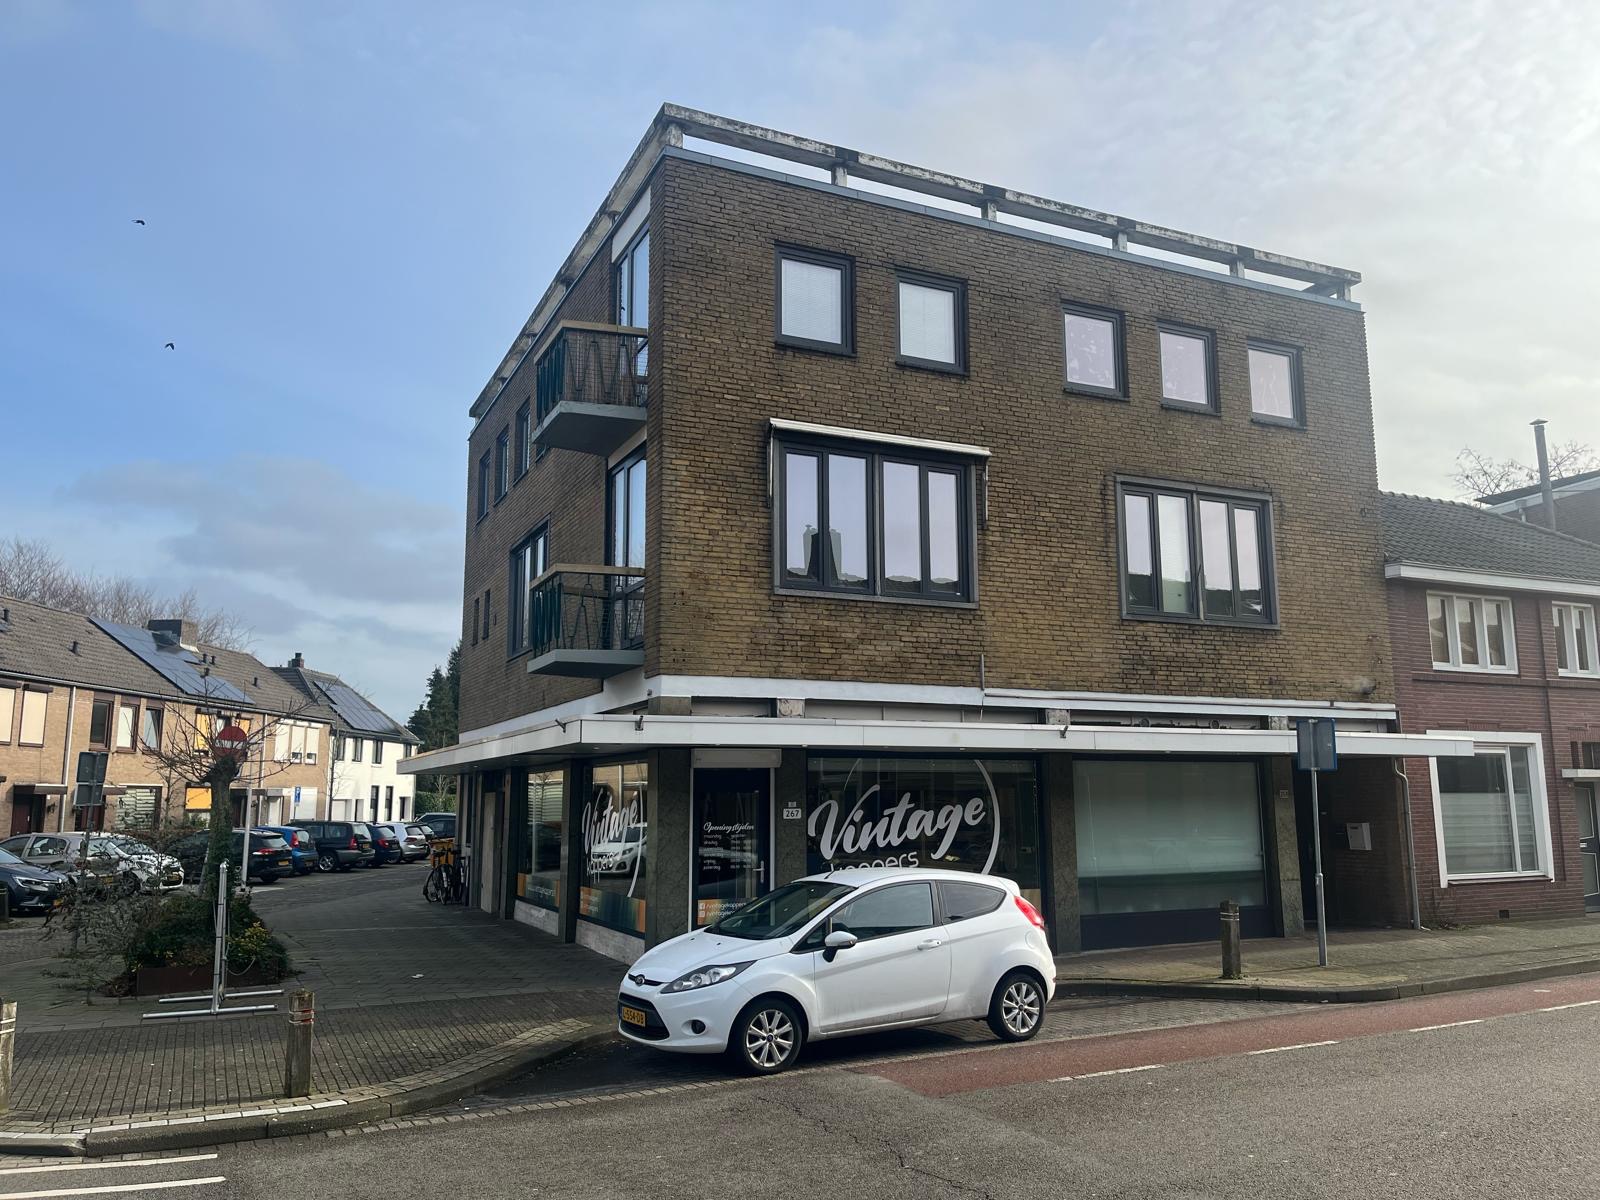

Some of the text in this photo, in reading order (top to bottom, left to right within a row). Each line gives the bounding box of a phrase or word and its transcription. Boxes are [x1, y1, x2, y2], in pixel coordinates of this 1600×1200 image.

[582, 788, 638, 860] Vintage
[703, 821, 755, 834] Openingstijden
[785, 810, 800, 818] 267
[808, 784, 986, 860] Vintage
